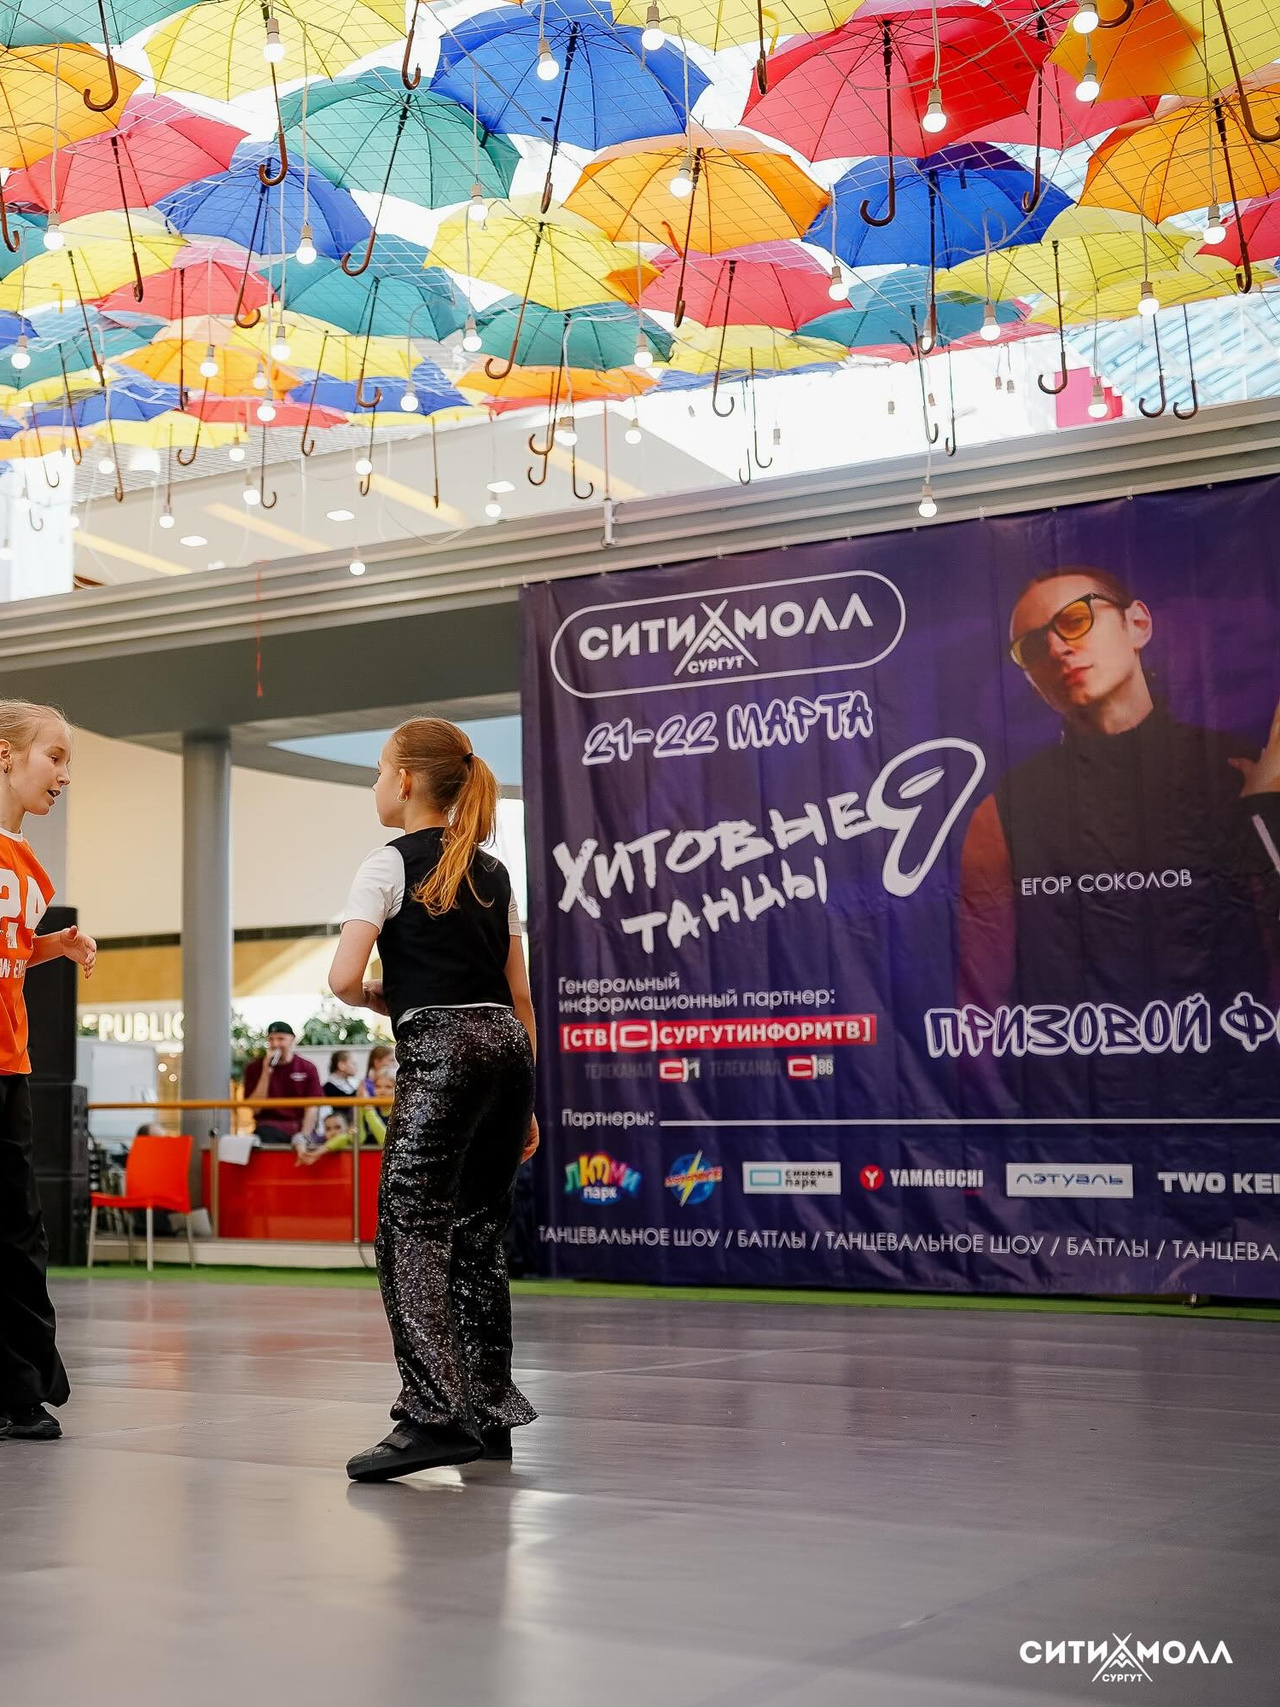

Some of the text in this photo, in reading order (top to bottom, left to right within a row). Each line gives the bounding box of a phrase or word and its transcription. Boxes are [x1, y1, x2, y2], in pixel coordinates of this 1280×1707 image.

[687, 655, 744, 674] СУРГУТ
[582, 690, 873, 766] 21-22 МАРТА
[553, 792, 878, 919] ХИТОВЫЕ
[1021, 869, 1192, 896] ЕГОР СОКОЛОВ
[621, 856, 827, 954] ТАНЦЫ
[558, 971, 680, 995] Генеральный
[559, 988, 836, 1016] информационный партнер:
[924, 991, 1280, 1058] ПРИЗОВОЙ Ф
[562, 1109, 655, 1129] Партнеры:
[890, 1169, 984, 1188] YAMAGUCHI
[1157, 1172, 1226, 1193] TWO
[539, 1225, 670, 1247] ТАНЦЕВАЛЬНОЕ
[673, 1229, 719, 1248] ШОУ
[738, 1230, 806, 1249] БАТТЛЫ
[826, 1231, 983, 1254] ТАНЦЕВАЛЬНОЕ
[990, 1236, 1044, 1255] ШОУ
[1067, 1237, 1148, 1258] БАТТЛЫ
[1172, 1240, 1280, 1262] ТАНЦЕВА
